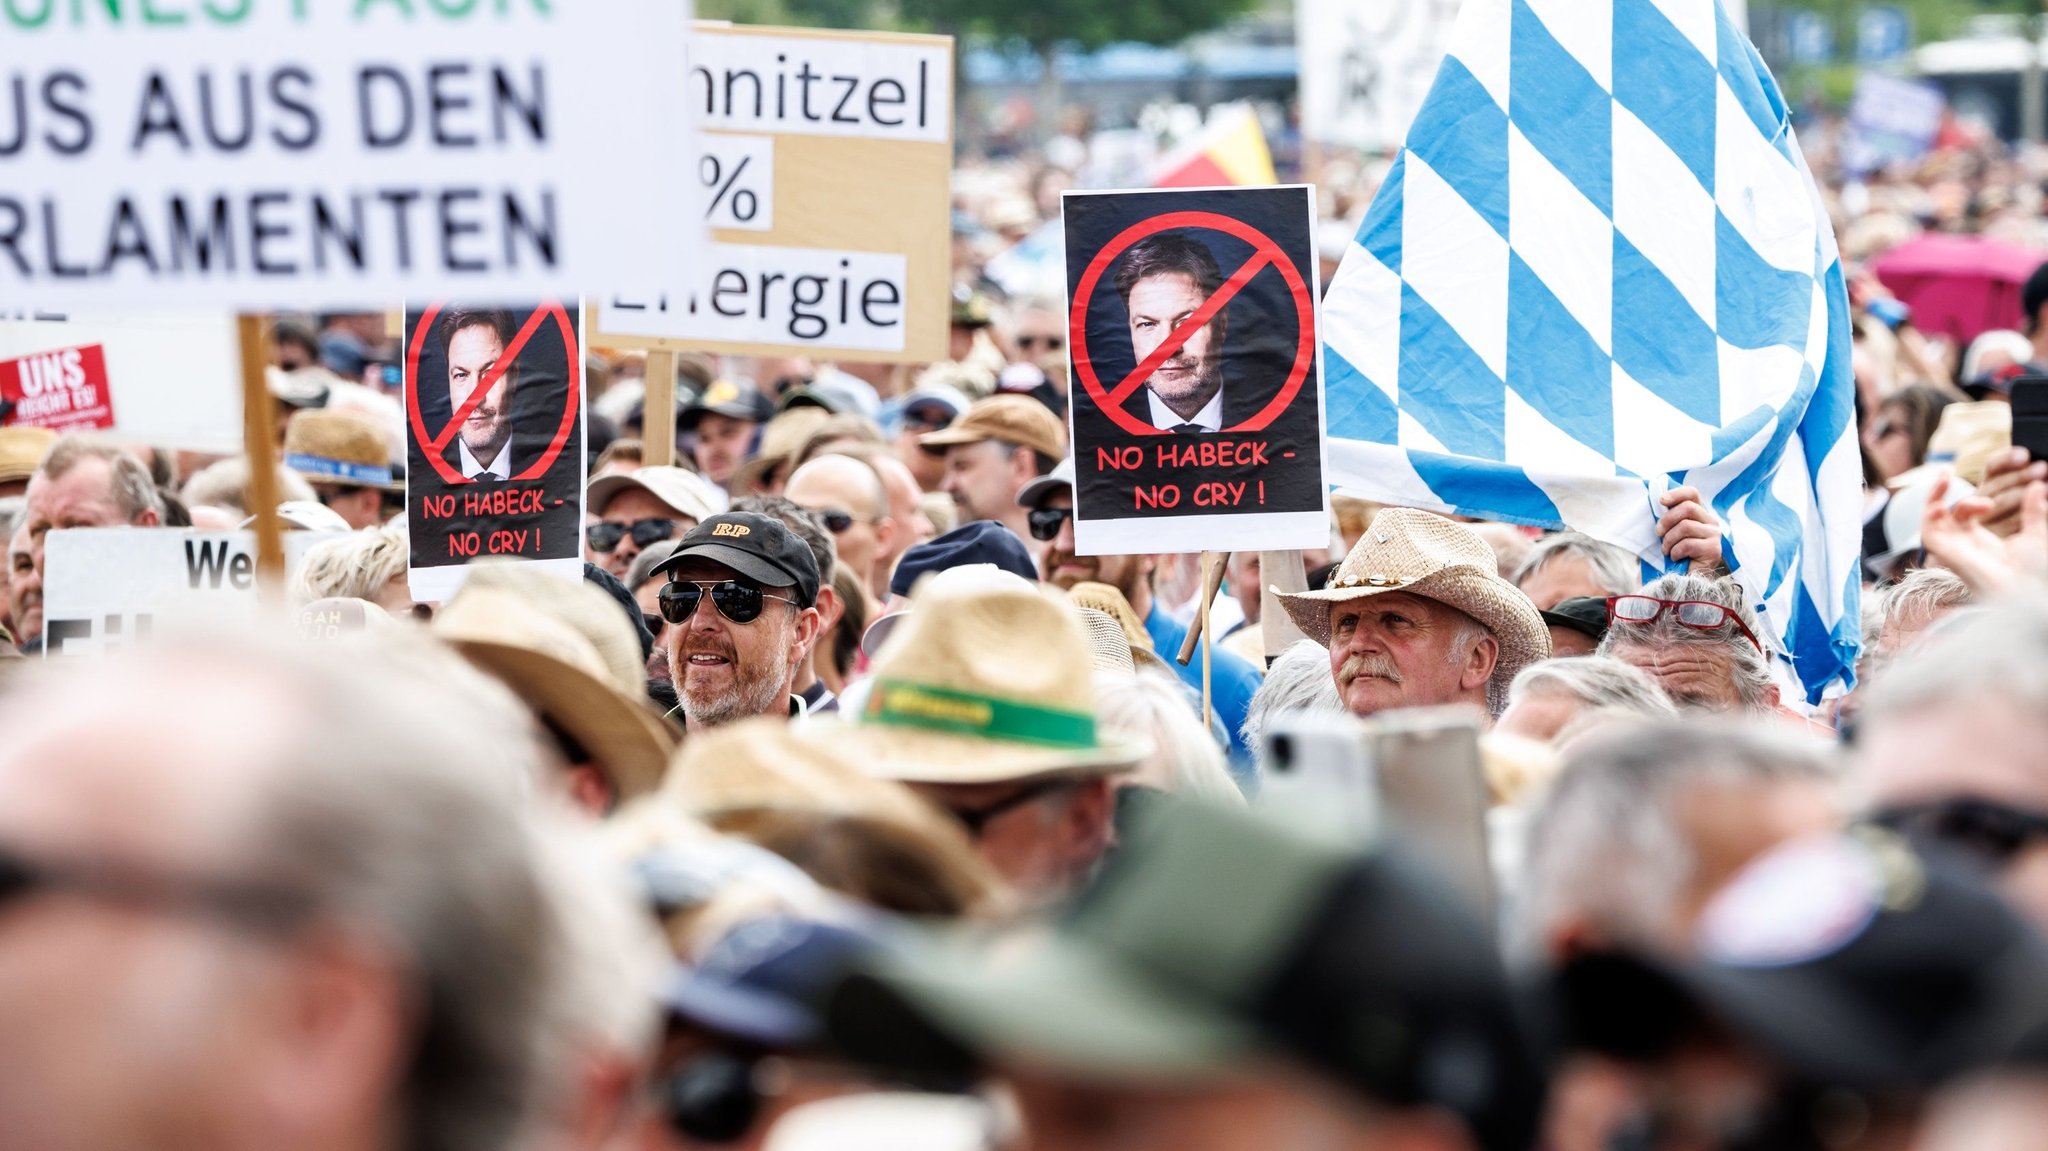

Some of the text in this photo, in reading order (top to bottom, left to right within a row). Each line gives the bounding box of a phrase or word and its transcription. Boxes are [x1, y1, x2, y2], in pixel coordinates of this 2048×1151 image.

[133, 66, 322, 153] AUS
[357, 62, 549, 149] DEN
[700, 154, 758, 222] %
[612, 258, 901, 340] ergie
[17, 347, 86, 398] UNS
[1097, 446, 1144, 471] NO
[1157, 441, 1269, 469] HABECK
[423, 495, 456, 519] NO
[464, 489, 545, 516] HABECK
[1134, 480, 1265, 510] NO CRY !
[449, 527, 541, 557] NO CRY !
[712, 523, 751, 538] RP
